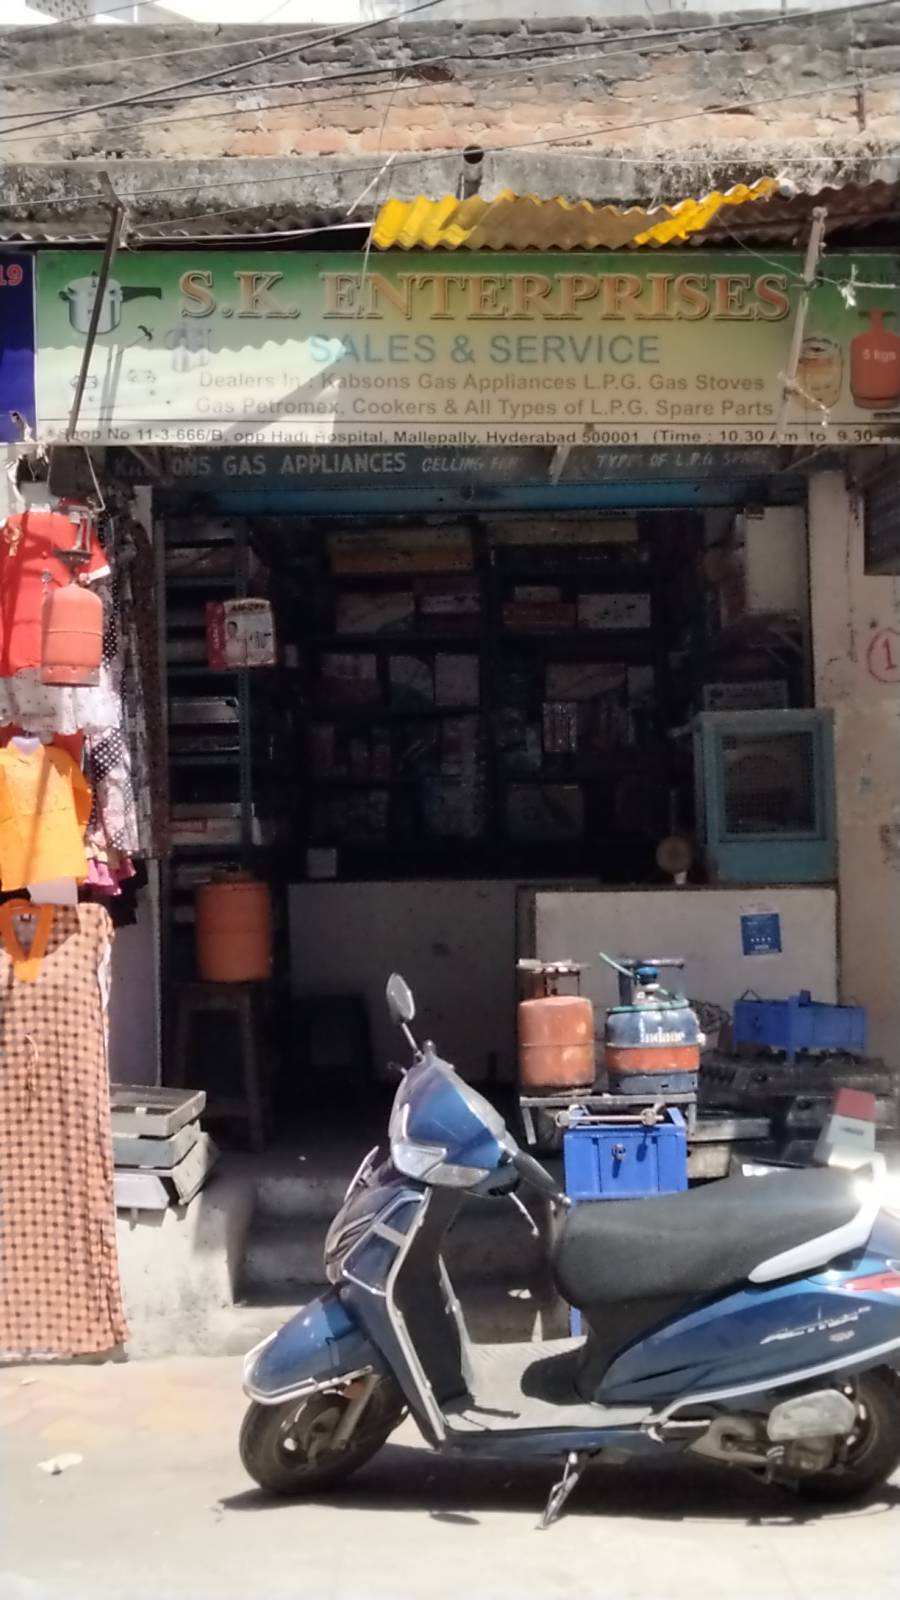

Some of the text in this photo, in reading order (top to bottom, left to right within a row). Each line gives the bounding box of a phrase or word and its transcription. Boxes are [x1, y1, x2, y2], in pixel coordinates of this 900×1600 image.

[179, 270, 790, 322] S.K. ENTERPRISES
[307, 333, 661, 364] SALES & SERVICE
[199, 372, 275, 388] Dealers
[321, 372, 410, 390] Kabsons
[417, 373, 456, 390] Gas
[463, 373, 576, 395] Appliances
[583, 374, 641, 390] L.P.G.
[649, 374, 688, 391] Gas
[695, 374, 765, 391] Stoves
[195, 398, 235, 414] Gas
[352, 398, 437, 415] Cookers
[444, 400, 459, 415] &
[464, 399, 491, 415] All
[498, 399, 557, 420] Types
[564, 399, 585, 416] of
[590, 400, 649, 417] L.P.G.
[655, 400, 715, 420] Spare
[721, 400, 774, 417] Parts
[107, 428, 130, 441] No
[234, 430, 266, 444] opp
[486, 430, 576, 444] Hyderabad
[582, 431, 638, 444] 500001
[652, 429, 702, 444] (Time
[719, 429, 765, 443] 10.30
[809, 430, 827, 443] to
[223, 454, 267, 476] GAS
[281, 451, 407, 475] APPLIANCES
